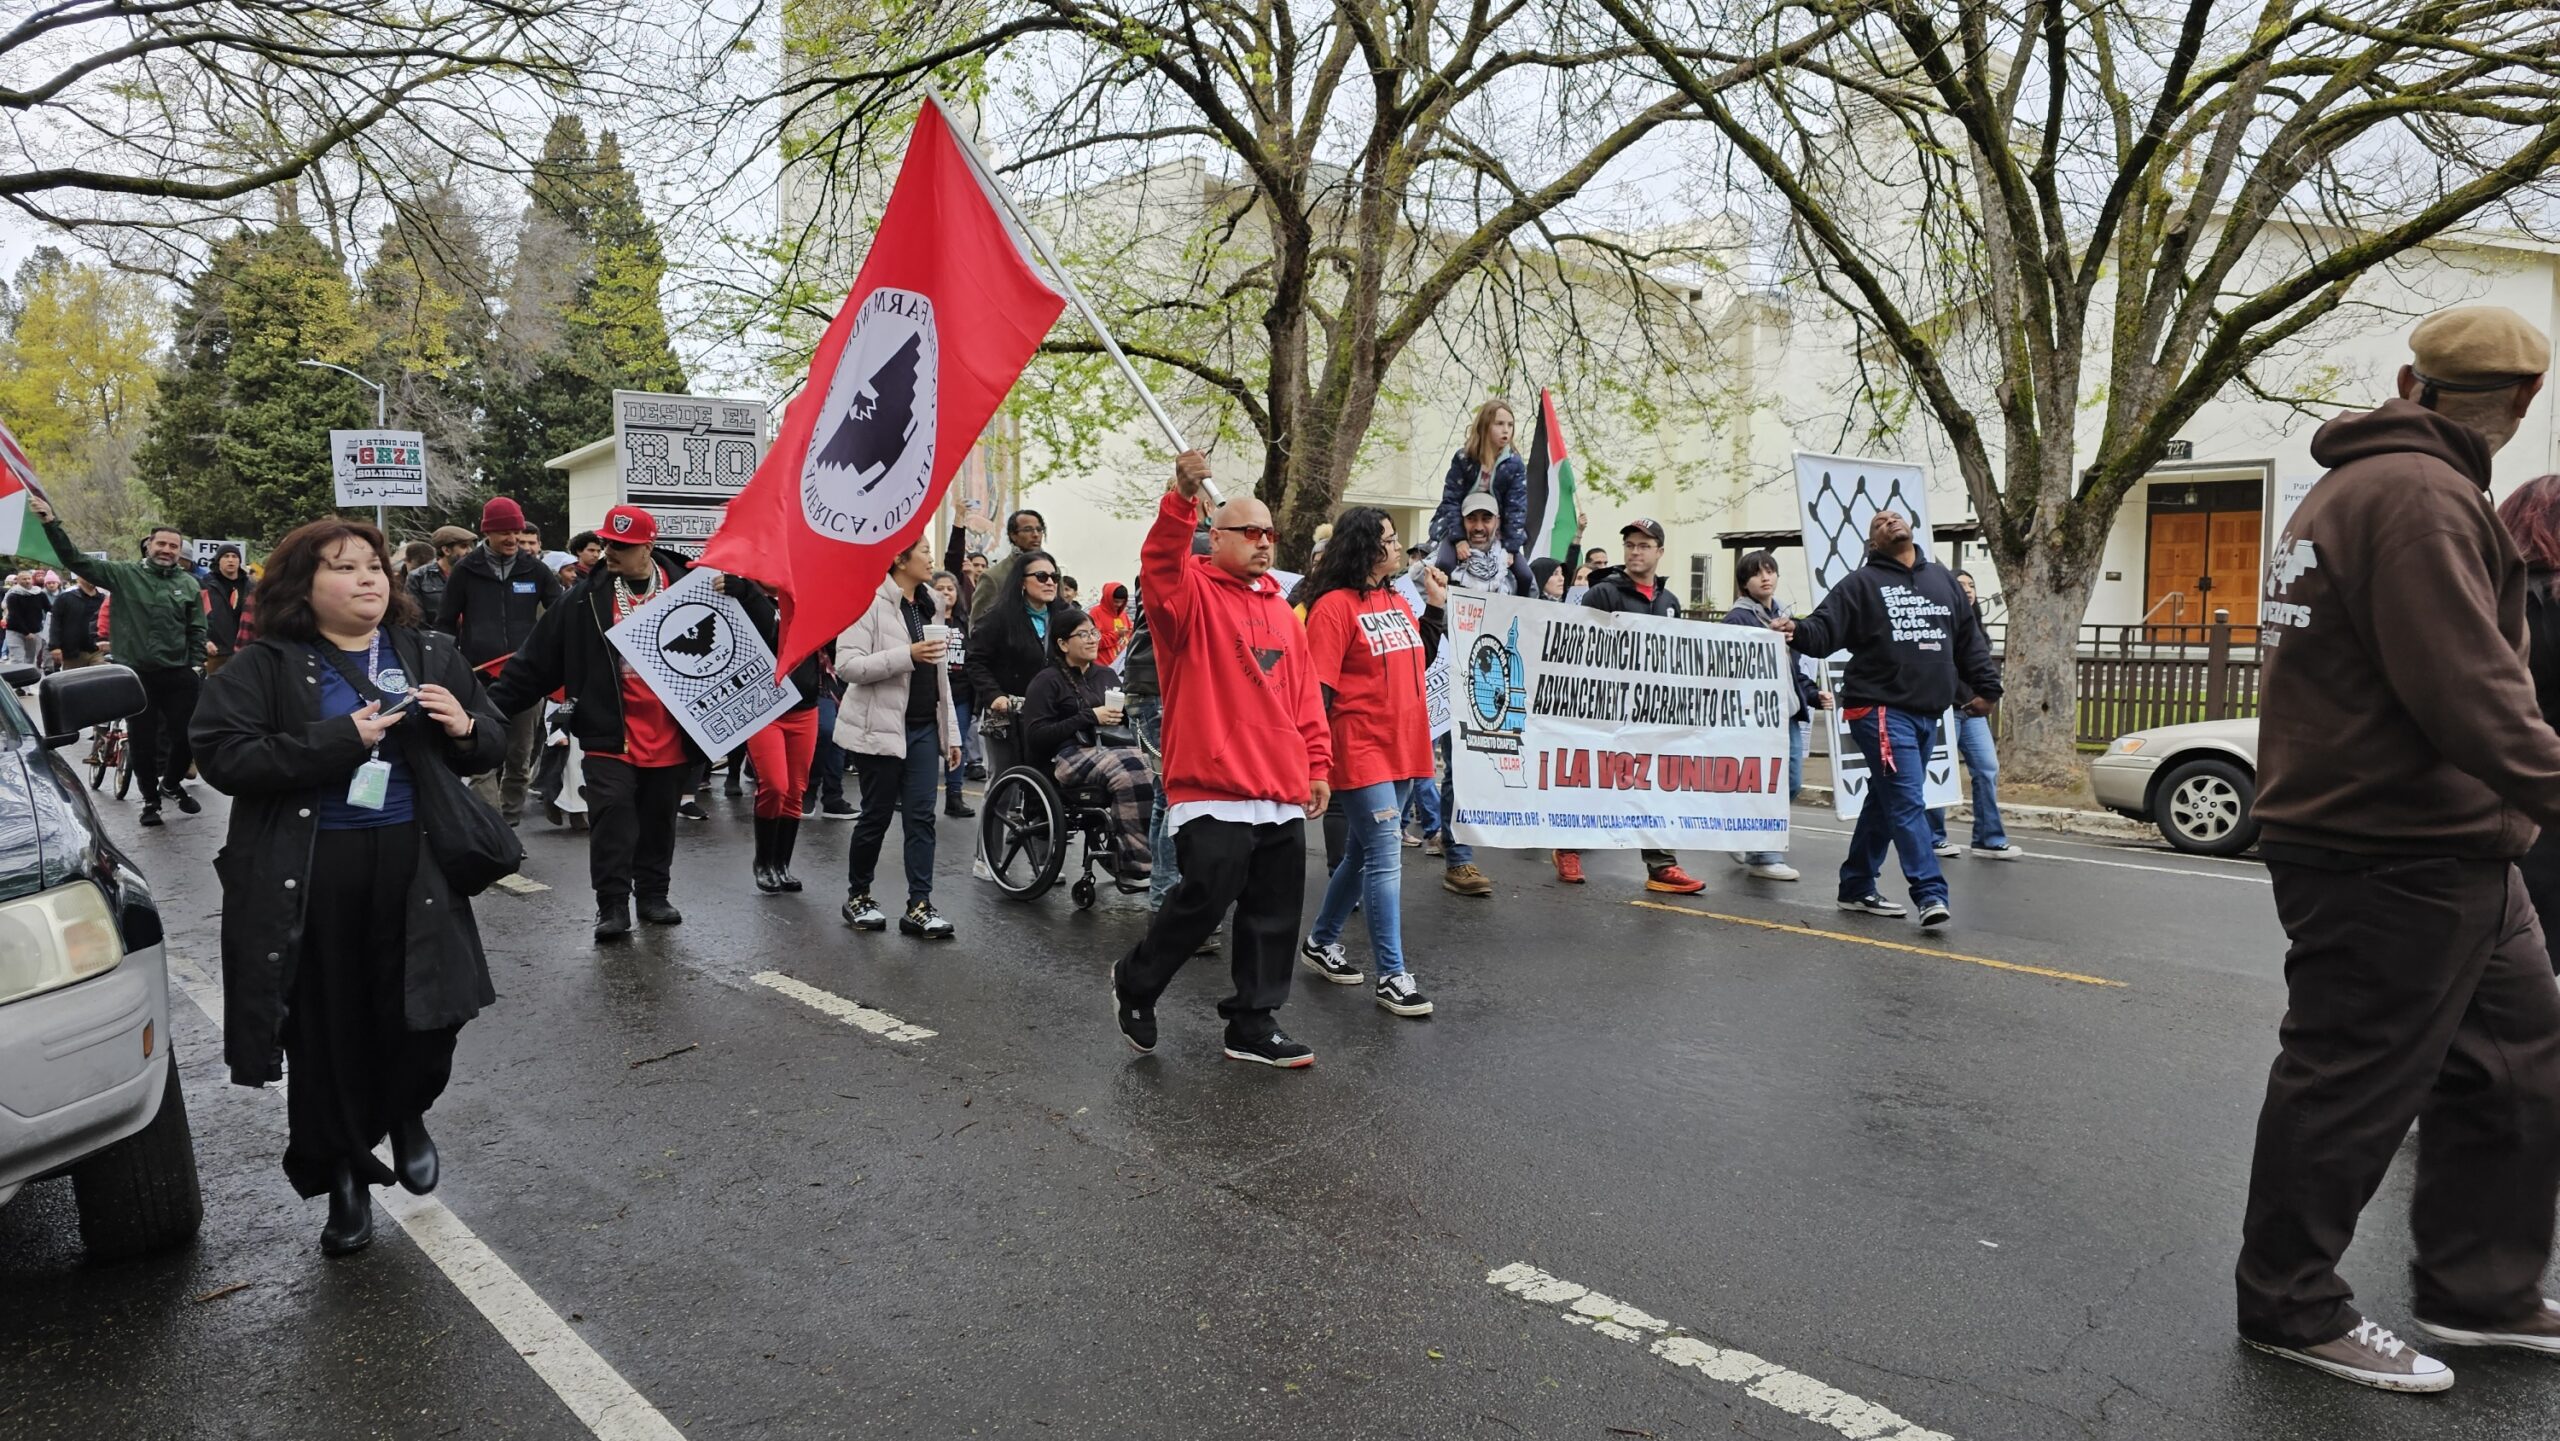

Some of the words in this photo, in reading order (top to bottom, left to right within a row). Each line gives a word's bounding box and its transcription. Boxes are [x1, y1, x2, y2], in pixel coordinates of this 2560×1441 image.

[624, 402, 712, 425] DESDE
[723, 408, 756, 429] EL
[359, 447, 421, 465] GAZA
[354, 483, 373, 497] حرة
[379, 483, 422, 497] فلسطين
[655, 515, 716, 534] ASTA
[1880, 585, 1912, 597] Eat.
[1885, 596, 1931, 608] Sleep.
[1888, 603, 1951, 619] Organize.
[1361, 612, 1410, 632] UNITE
[1890, 618, 1930, 629] Vote.
[1370, 629, 1421, 653] HERE!
[1892, 628, 1947, 642] Repeat.
[1541, 621, 1585, 665] LABOR
[1585, 626, 1641, 671] COUNCIL
[1644, 633, 1667, 673] FOR
[1669, 635, 1704, 676] LATIN
[1707, 640, 1778, 680] AMERICAN
[687, 680, 738, 719] RAZA
[738, 656, 770, 686] CON
[701, 673, 788, 744] GAZA
[1532, 674, 1630, 725] ADVANCEMENT,
[1632, 683, 1717, 727] SACRAMENTO
[1466, 734, 1496, 749] SACRAMENTO
[1497, 737, 1518, 750] CHAPTER
[1555, 748, 1590, 788] LA
[1597, 750, 1652, 790] VOZ
[1658, 754, 1762, 793] UNIDA
